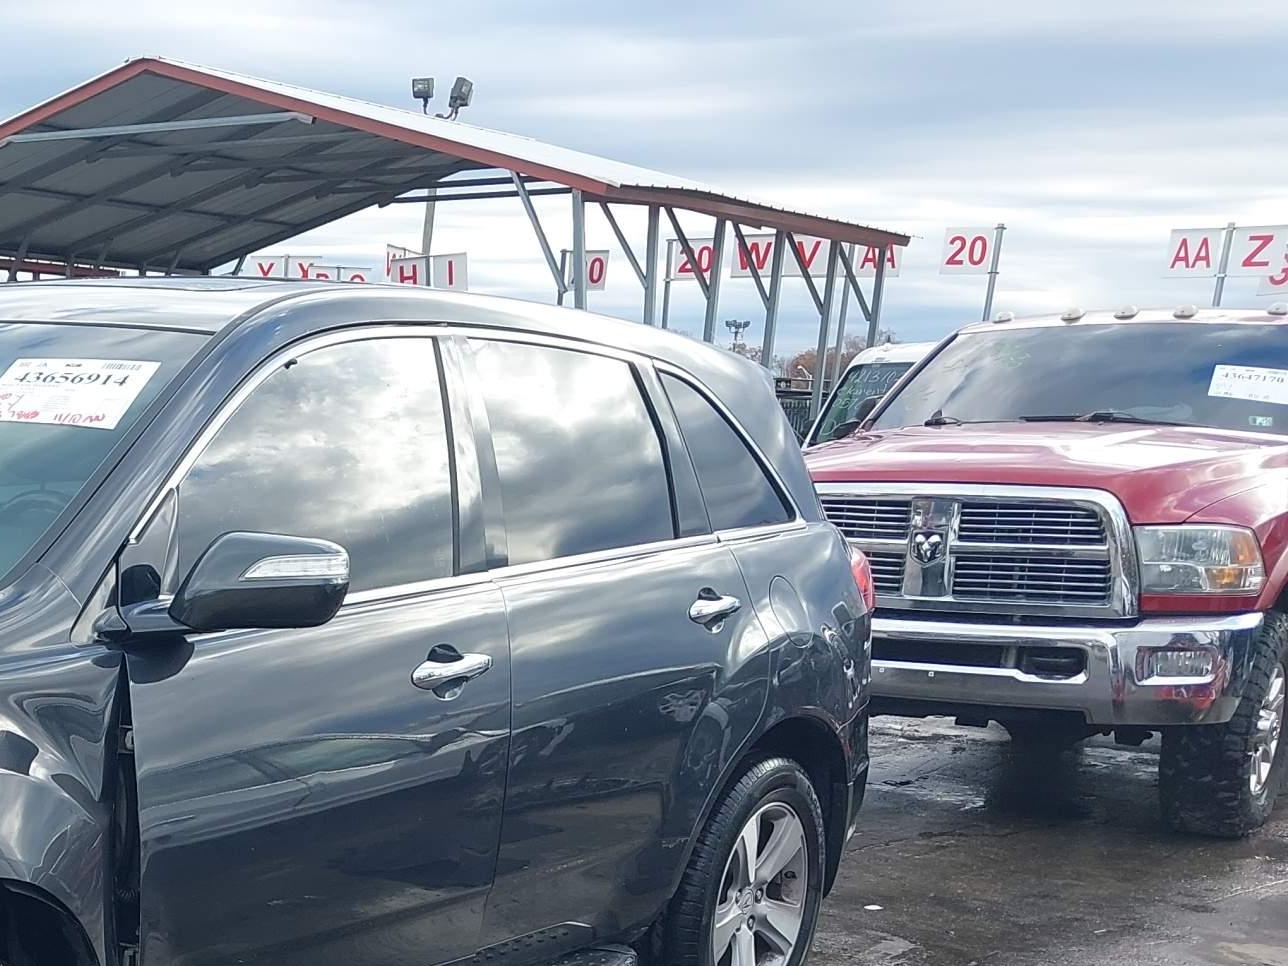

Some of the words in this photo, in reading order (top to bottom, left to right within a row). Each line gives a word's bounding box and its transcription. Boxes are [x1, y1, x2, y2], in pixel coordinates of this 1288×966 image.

[678, 246, 713, 273] 20
[738, 242, 773, 270] W
[797, 241, 821, 269] V
[945, 236, 987, 265] 20
[1170, 237, 1211, 268] AA
[1241, 235, 1274, 266] Z
[14, 371, 130, 386] 43656914
